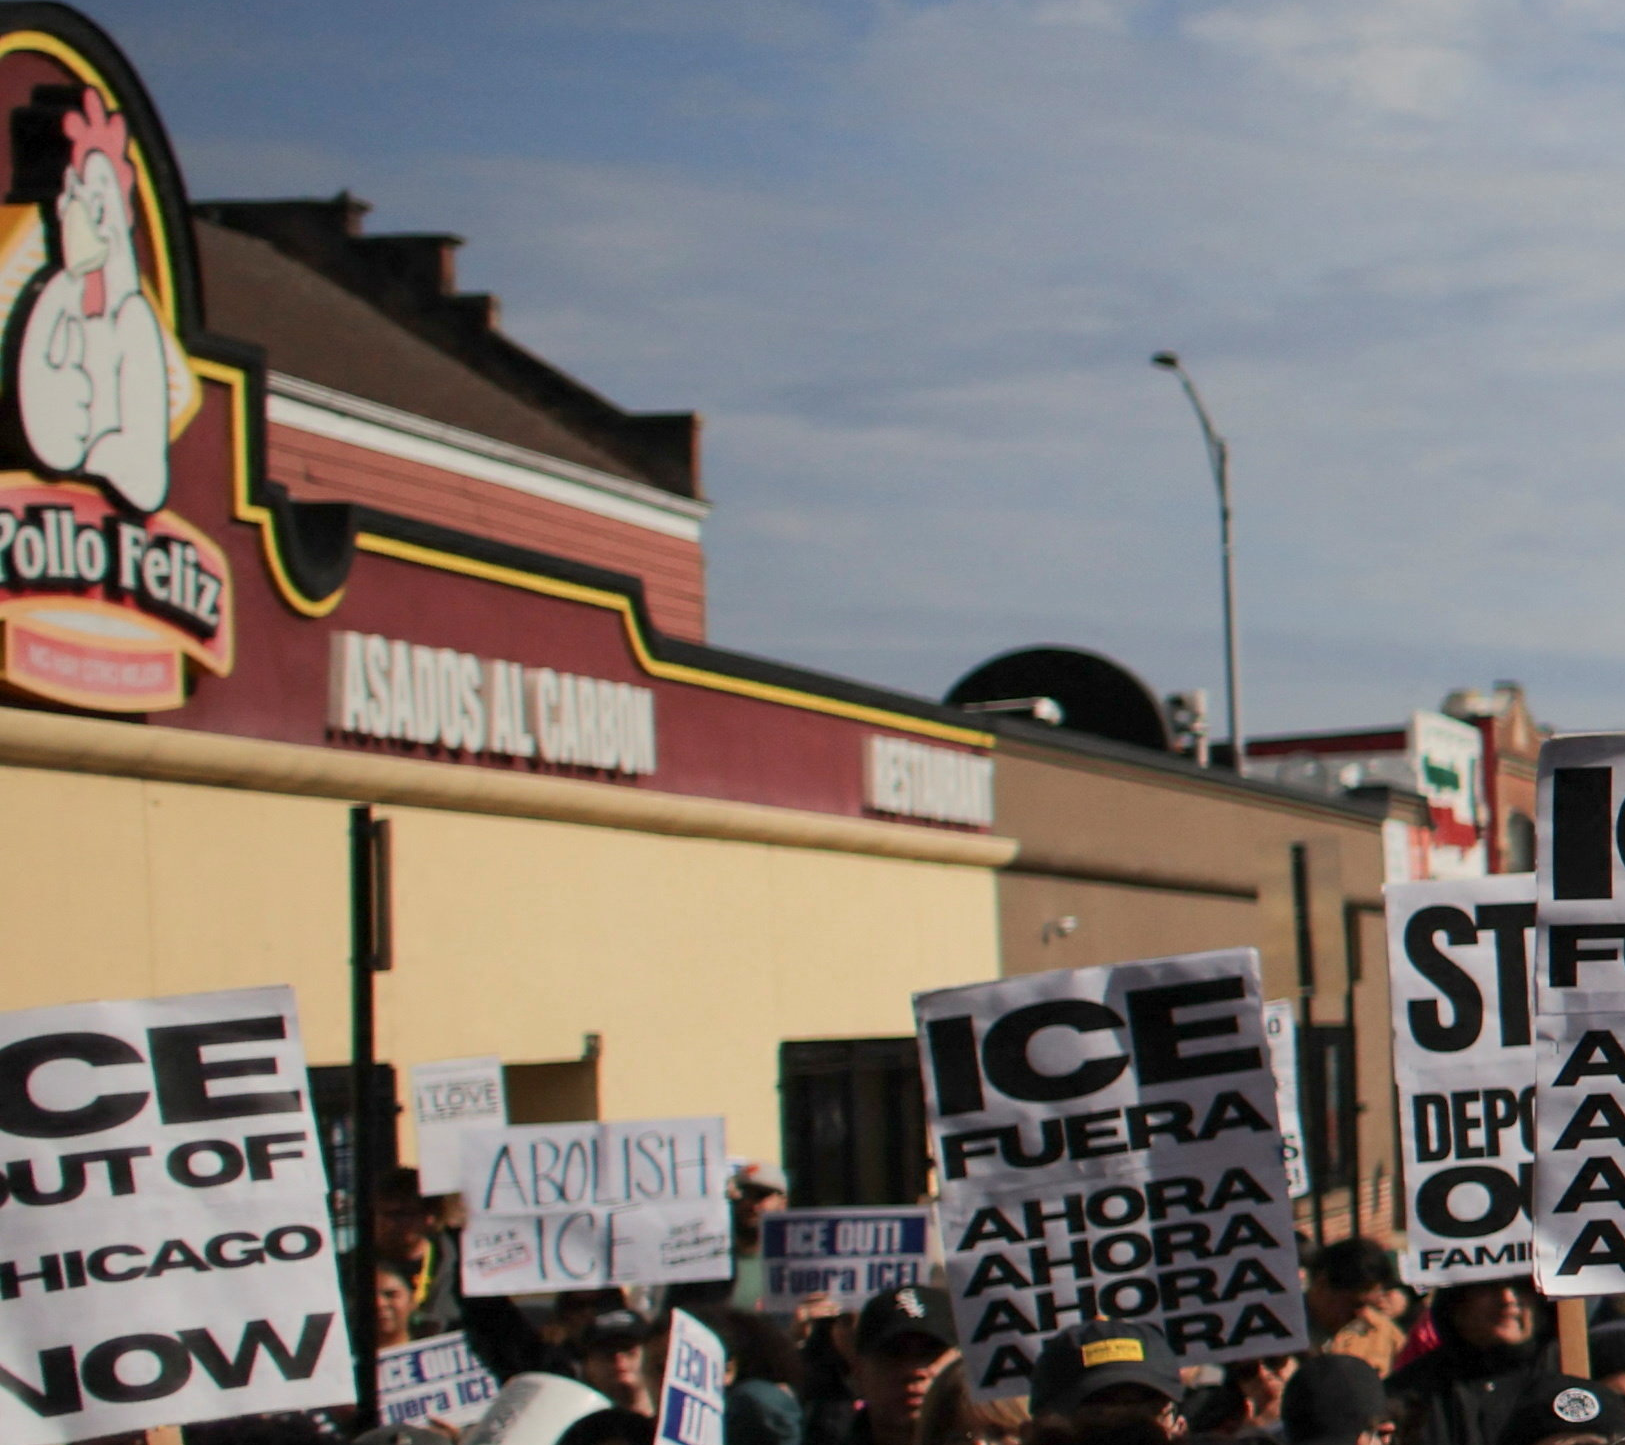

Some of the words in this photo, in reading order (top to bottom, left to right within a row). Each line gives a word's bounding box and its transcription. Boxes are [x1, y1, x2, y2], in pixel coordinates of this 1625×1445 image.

[0, 508, 108, 582] Pollo
[118, 522, 222, 626] Feliz
[340, 629, 485, 753] ASADOS
[489, 658, 536, 757] AL
[0, 1014, 305, 1140] CE
[926, 976, 1263, 1118] ICE
[430, 1083, 498, 1112] LOVE
[940, 1090, 1272, 1180] FUERA
[0, 1145, 153, 1210] UT
[166, 1131, 307, 1189] OF
[483, 1129, 709, 1210] ABOLISH
[956, 1166, 1274, 1252] AHORA
[534, 1201, 642, 1283] ICE
[785, 1219, 830, 1255] ICE
[836, 1219, 902, 1255] OUT!
[962, 1213, 1280, 1298] AHORA
[1419, 1239, 1534, 1272] FAMI
[971, 1258, 1286, 1343] AHORA
[0, 1311, 336, 1419] NOW
[980, 1302, 1294, 1389] ARA
